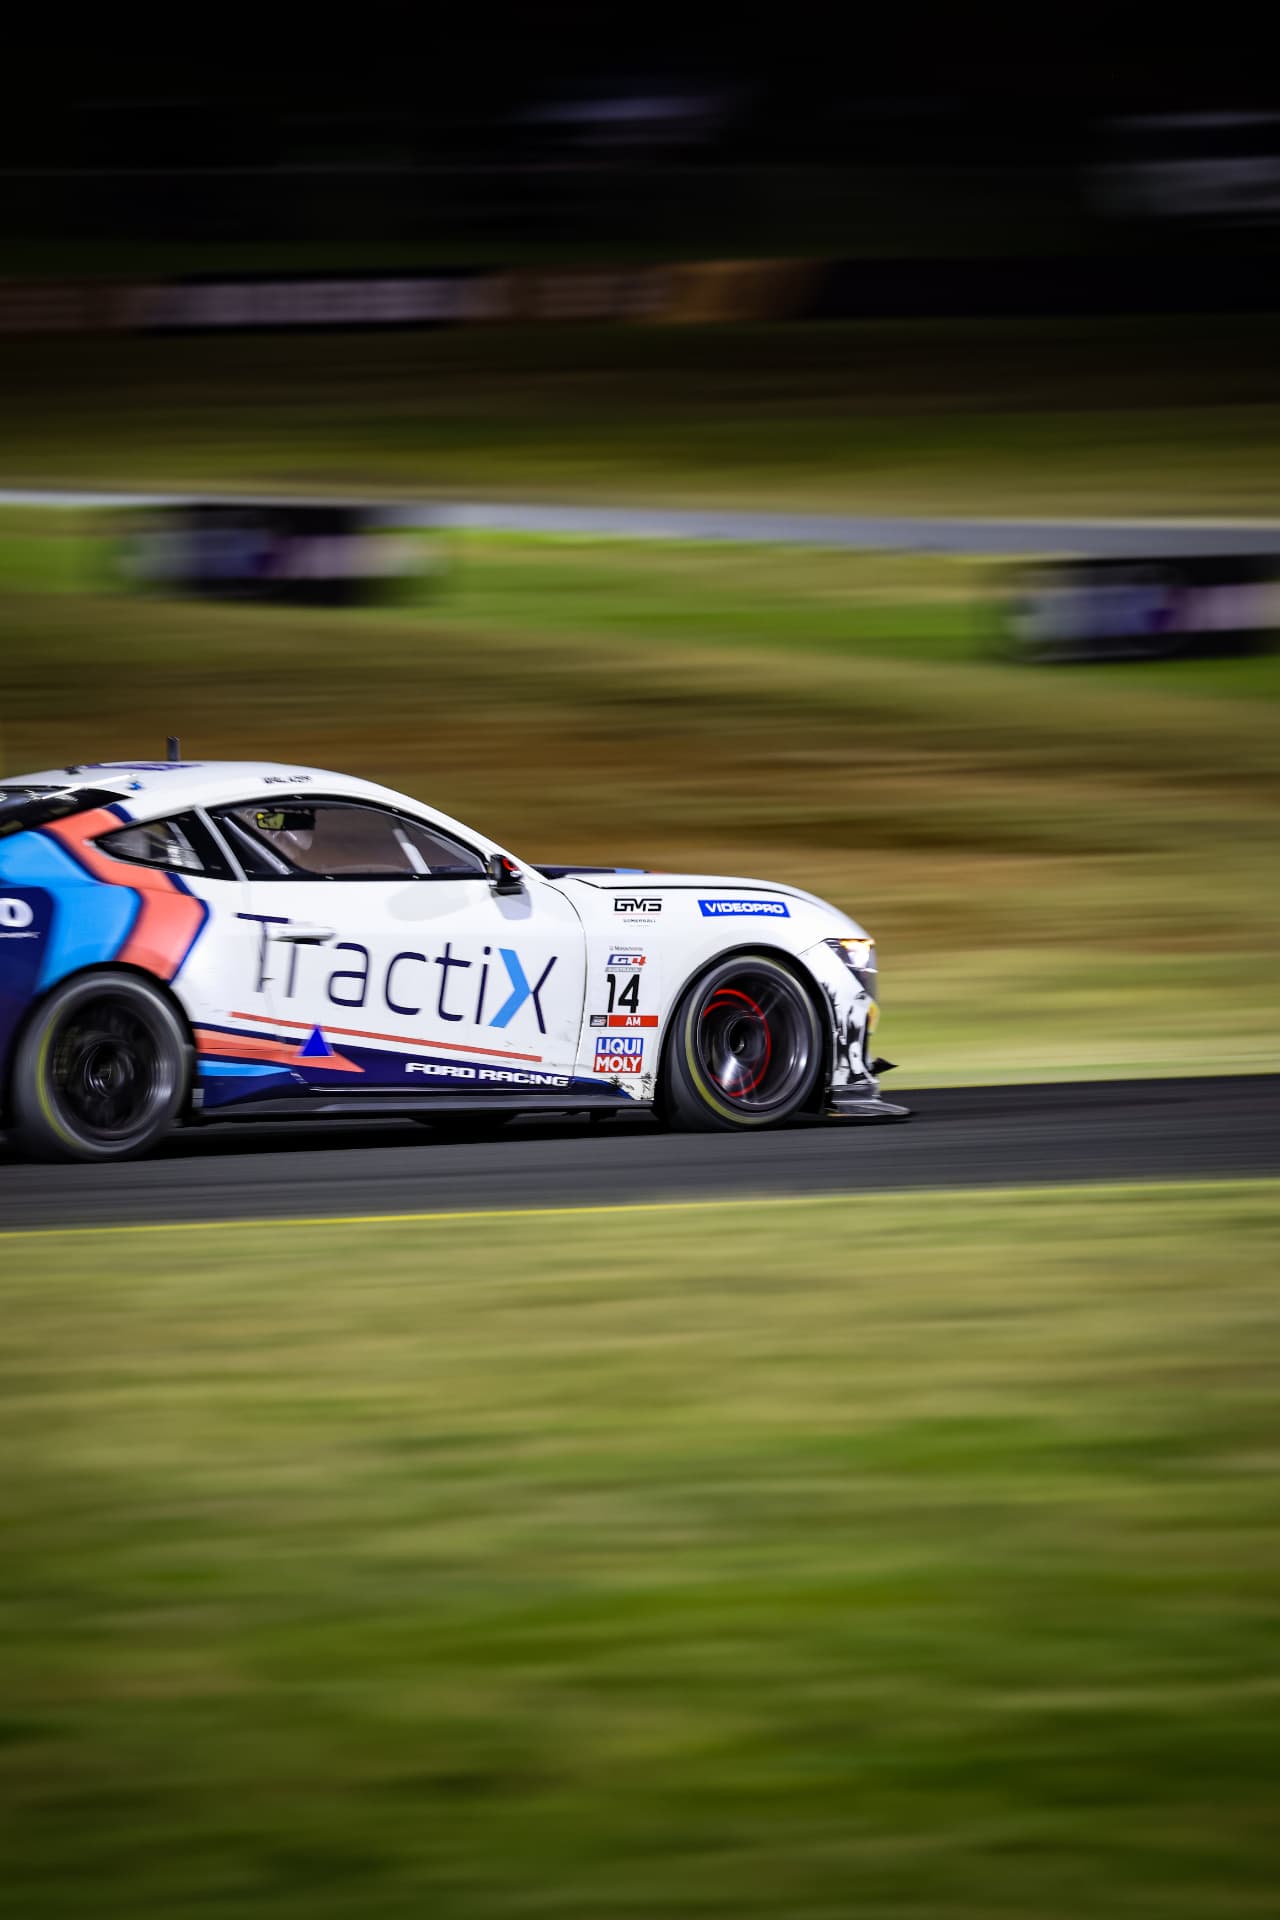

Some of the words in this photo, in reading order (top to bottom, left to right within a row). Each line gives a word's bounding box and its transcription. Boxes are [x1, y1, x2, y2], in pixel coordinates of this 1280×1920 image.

[614, 898, 662, 912] GMS
[705, 903, 784, 915] VIDEOPRO
[606, 973, 640, 1013] 14
[625, 1017, 641, 1026] AM
[597, 1038, 641, 1054] LIQUI
[595, 1056, 641, 1072] MOLY
[405, 1062, 476, 1079] FORD
[478, 1069, 569, 1087] RACING
